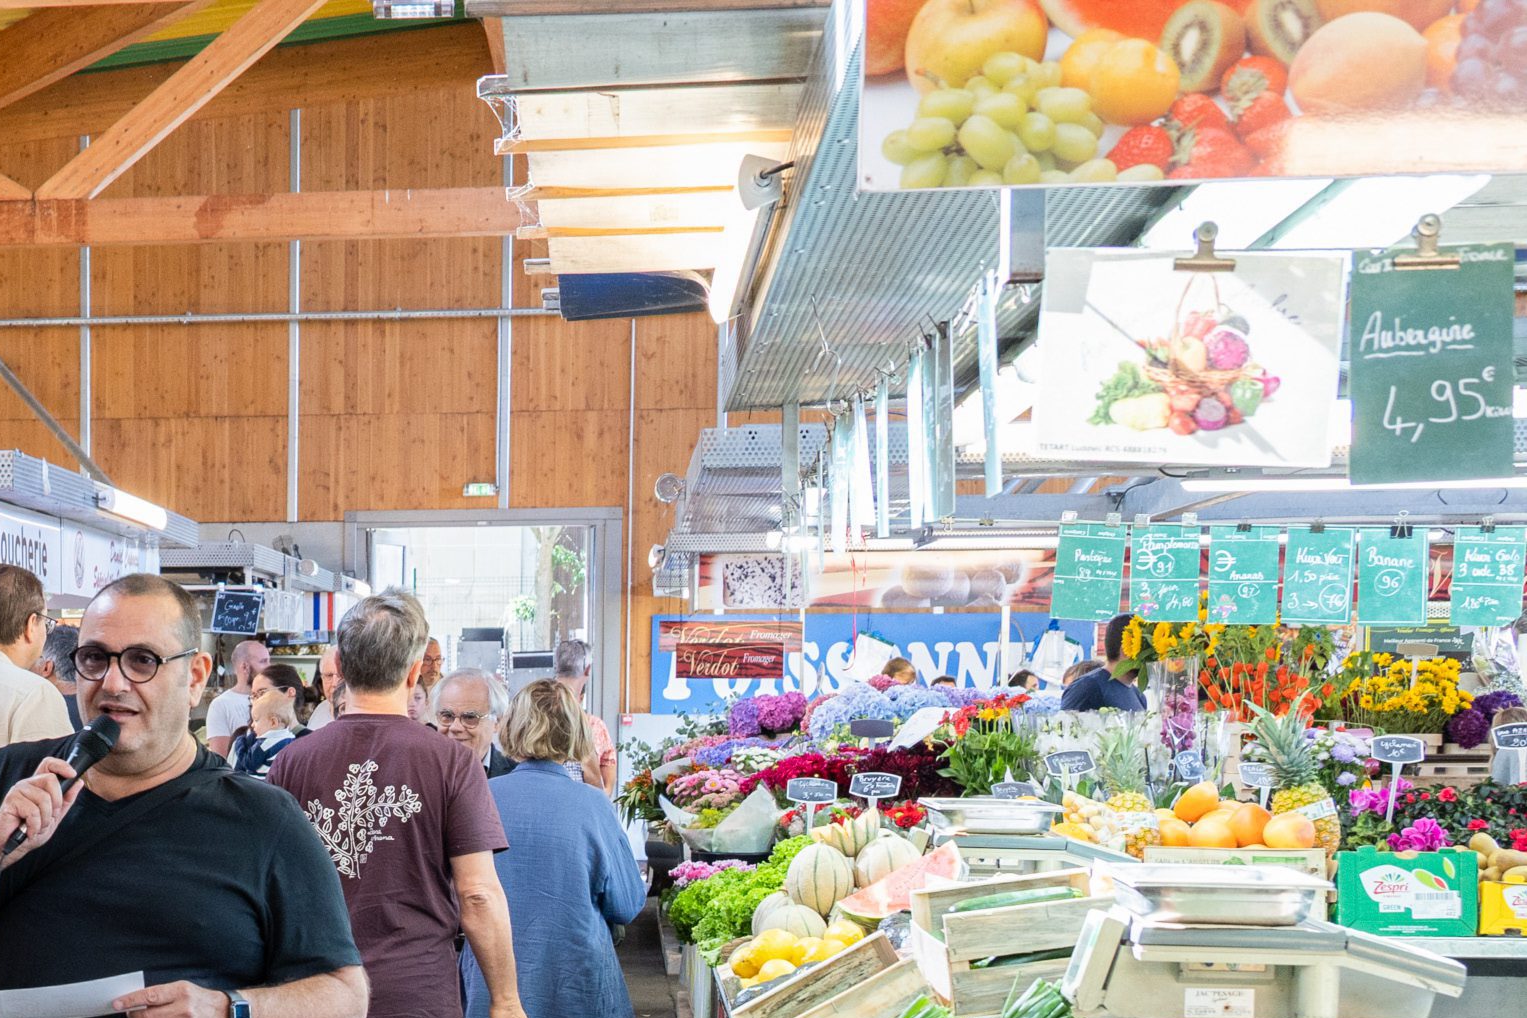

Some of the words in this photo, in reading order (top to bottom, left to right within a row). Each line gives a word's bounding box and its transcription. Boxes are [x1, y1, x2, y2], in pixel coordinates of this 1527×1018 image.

[1359, 311, 1476, 354] Aubergine
[1366, 546, 1416, 568] Banane
[1229, 570, 1265, 581] Ananas
[1376, 575, 1401, 589] 96
[748, 629, 794, 641] Fromager
[678, 650, 740, 677] Verdot
[742, 653, 776, 665] Fromager
[1373, 880, 1409, 895] Zespri
